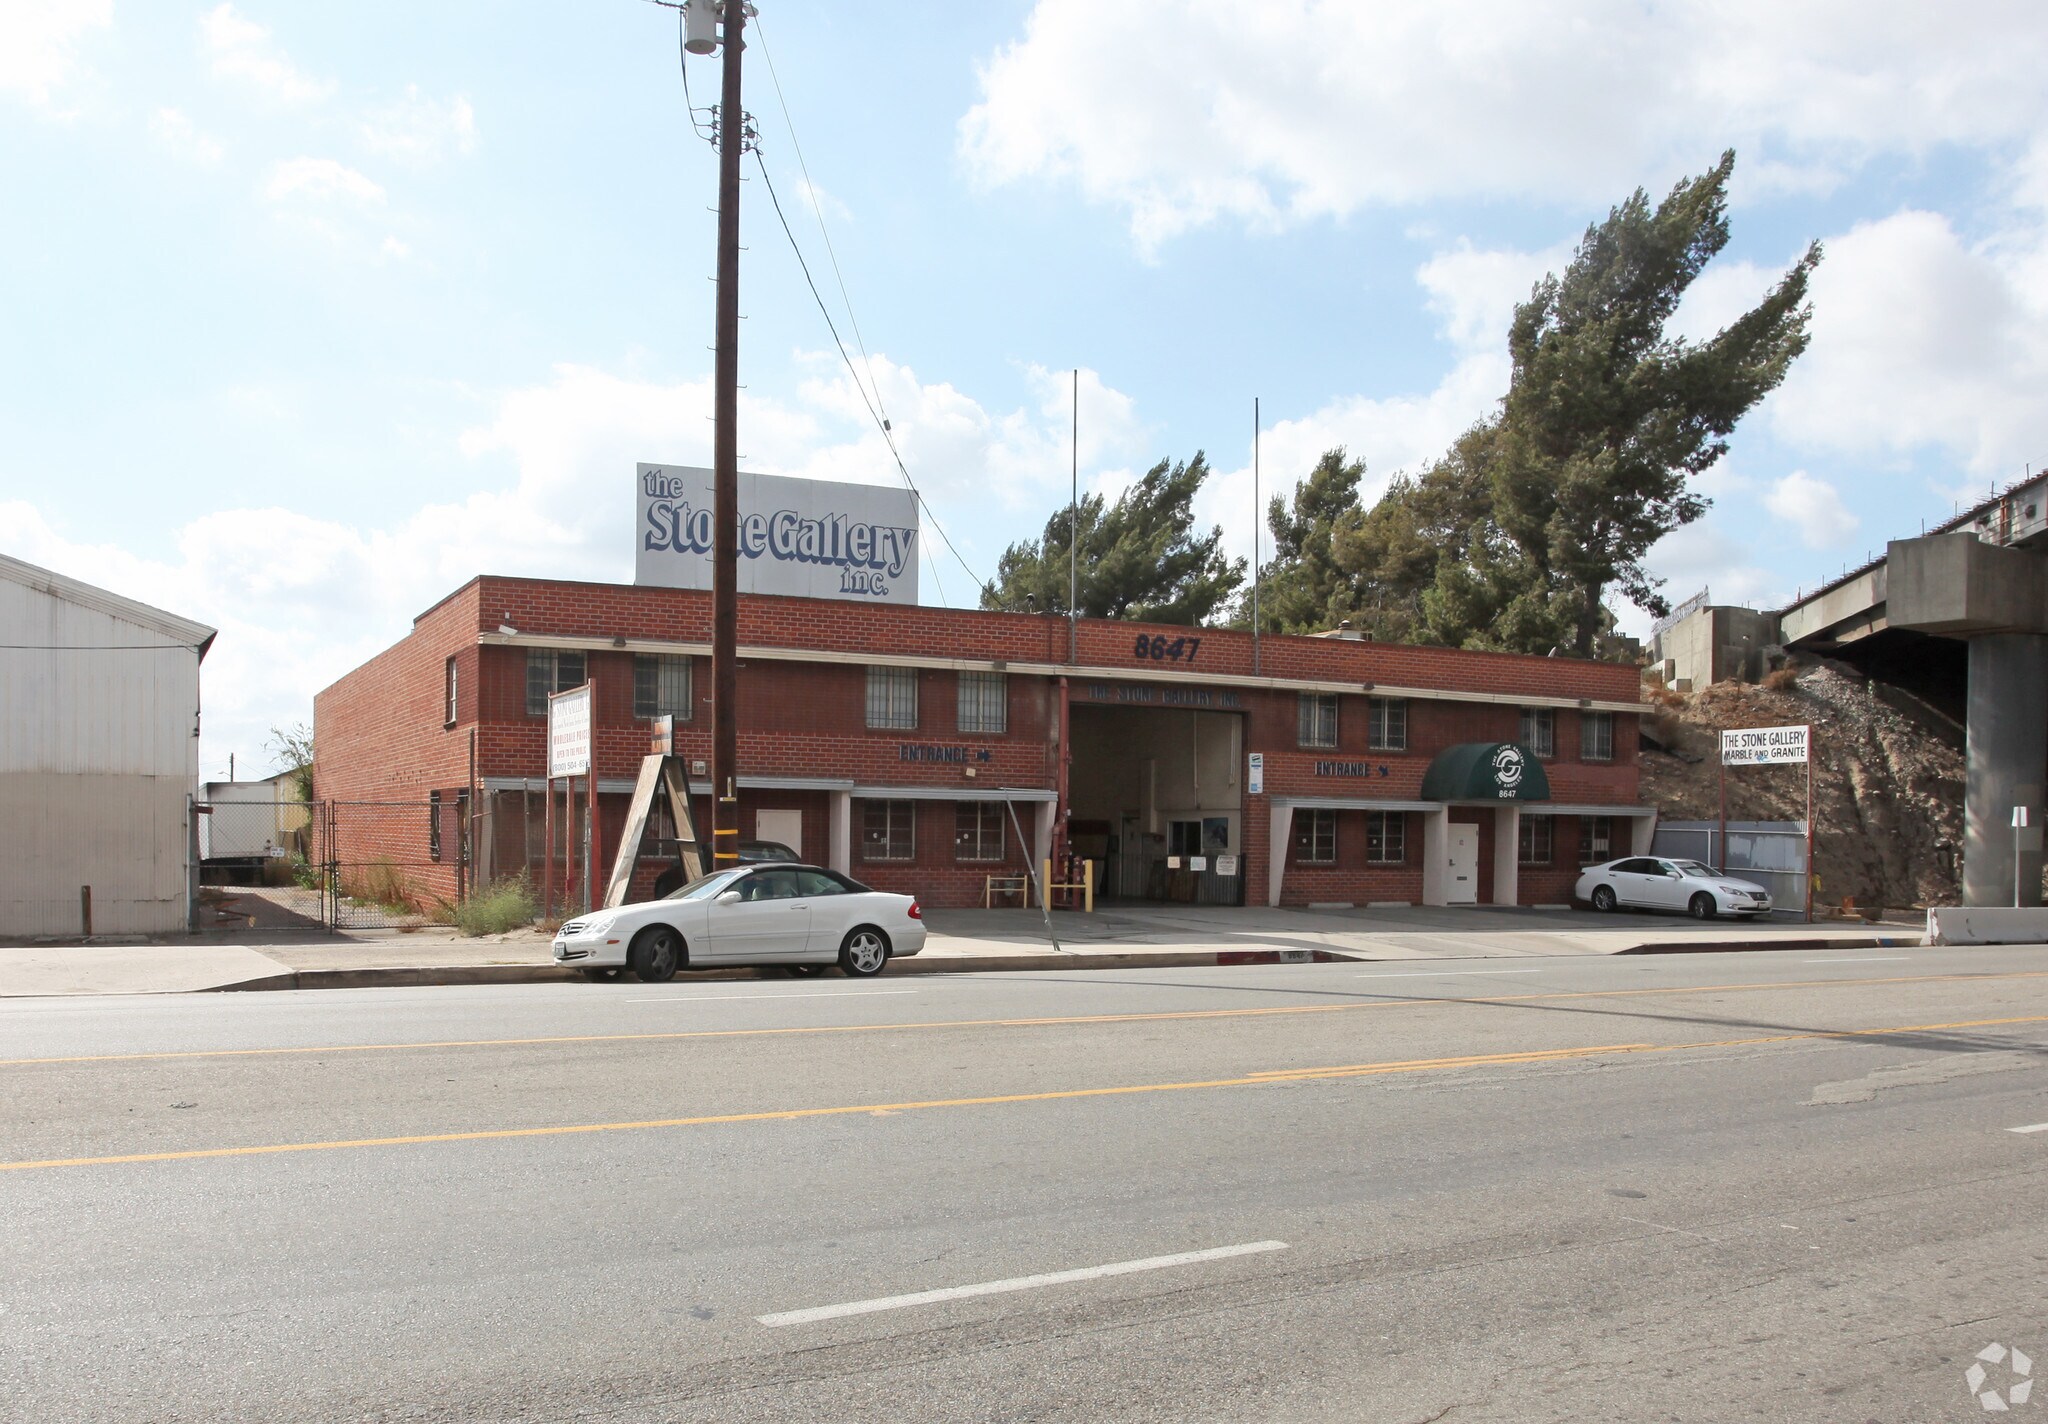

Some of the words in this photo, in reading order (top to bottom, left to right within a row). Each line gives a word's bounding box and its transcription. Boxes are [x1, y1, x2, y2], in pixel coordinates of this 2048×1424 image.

[643, 469, 683, 499] the
[645, 500, 767, 559] Stoe
[839, 565, 889, 596] inc.
[1134, 633, 1201, 663] 8647
[1724, 734, 1739, 748] THE
[1742, 733, 1767, 747] STONE
[1769, 730, 1806, 746] GALLERY
[899, 744, 969, 762] ENTRANCE
[1723, 749, 1752, 760] MARBLE
[1754, 749, 1769, 758] AND
[1771, 746, 1805, 758] GRANITE
[1314, 761, 1370, 777] ENTRANCE
[1498, 790, 1516, 798] 8647
